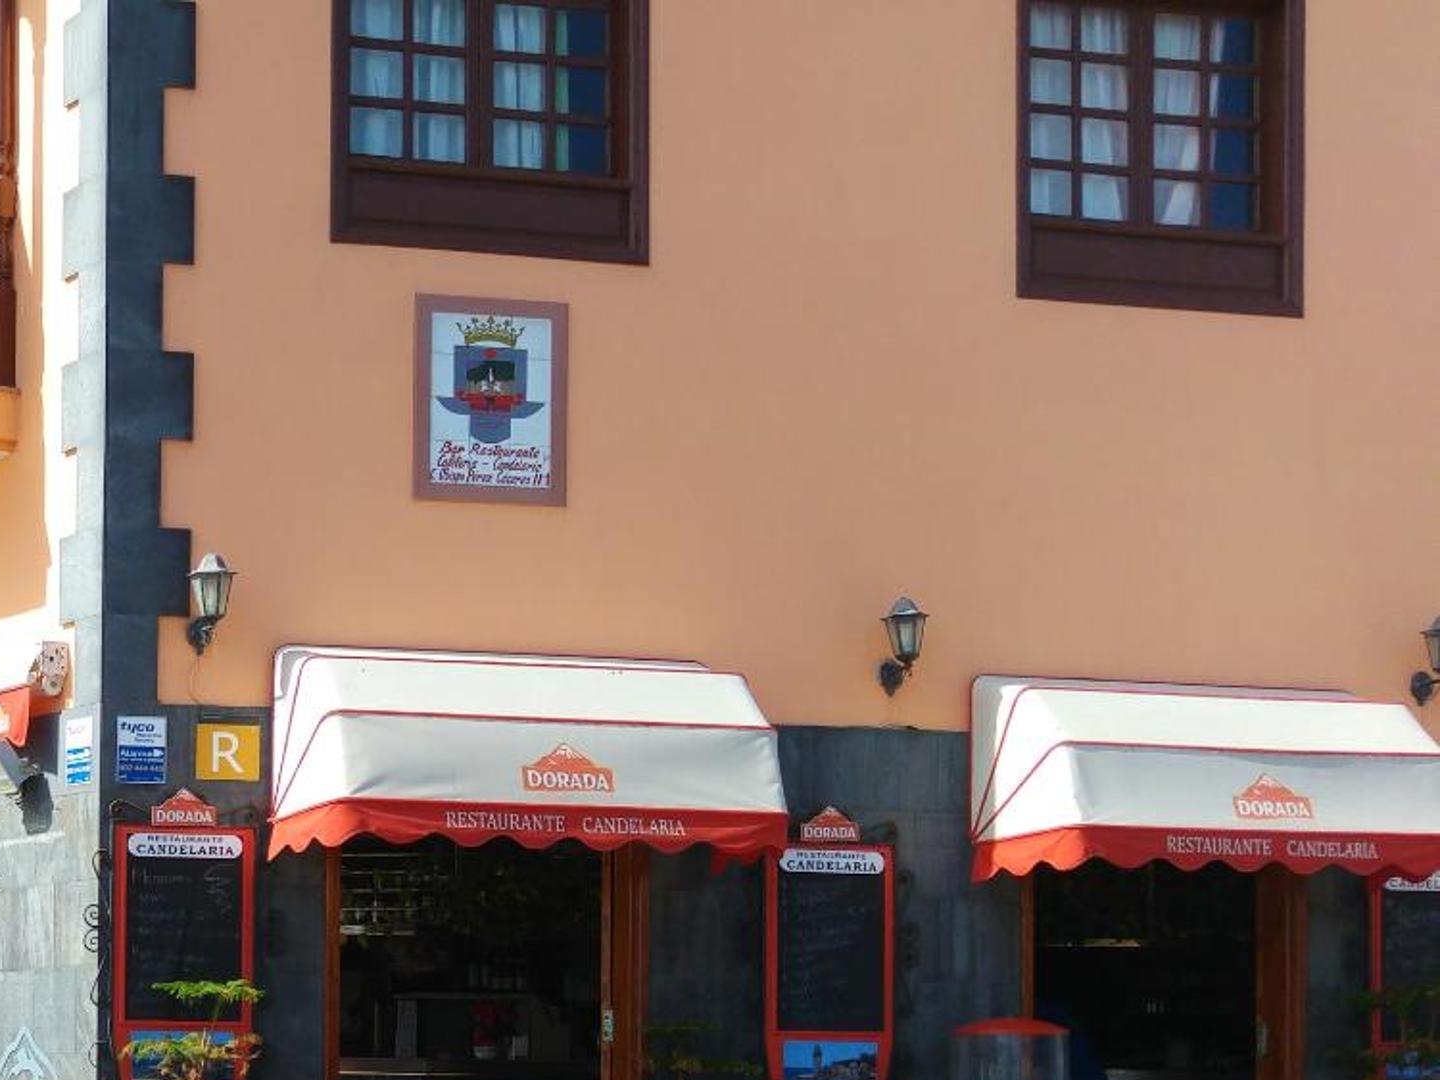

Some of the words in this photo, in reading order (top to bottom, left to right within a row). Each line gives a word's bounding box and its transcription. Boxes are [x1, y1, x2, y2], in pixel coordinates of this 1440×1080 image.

[120, 721, 155, 734] tyco
[212, 731, 244, 773] R
[526, 769, 609, 791] DORADA
[155, 809, 213, 824] DORADA
[1238, 799, 1311, 818] DORADA
[446, 811, 565, 834] RESTAURANTE
[582, 816, 687, 836] CANDELARIA
[803, 826, 857, 839] DORADA
[135, 843, 235, 857] CANDELARIA
[1166, 835, 1273, 857] RESTAURANTE
[1285, 839, 1380, 860] CANDELARIA
[786, 859, 877, 873] CANDELARIA
